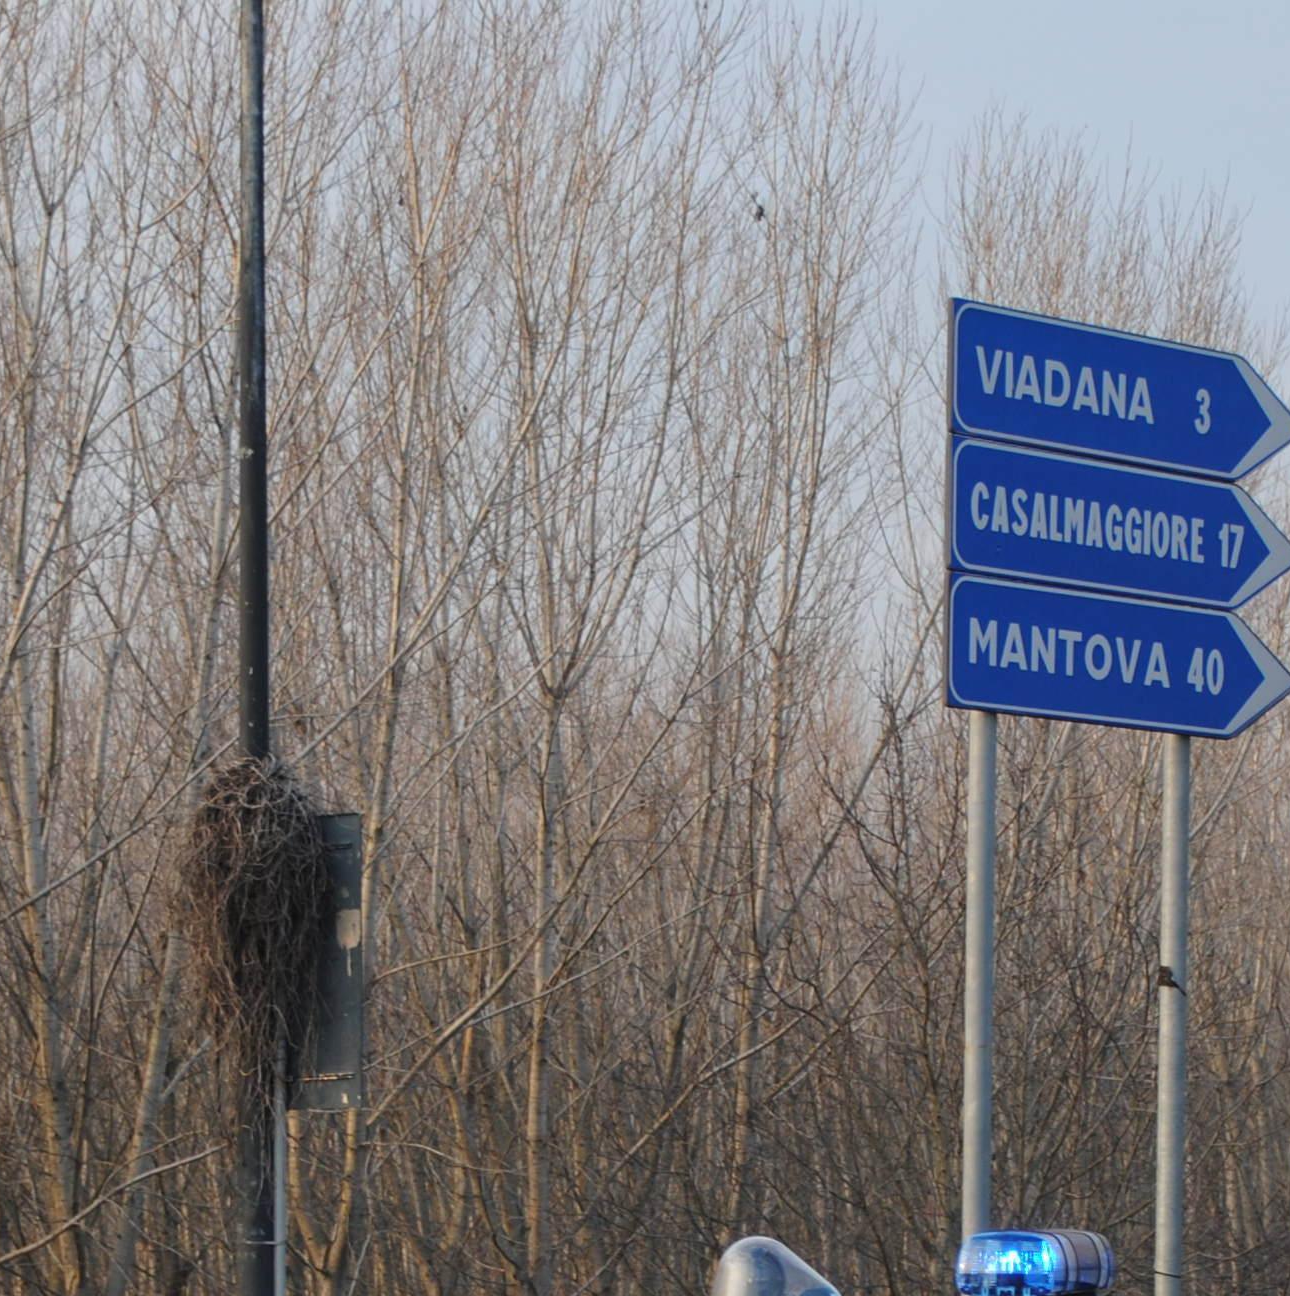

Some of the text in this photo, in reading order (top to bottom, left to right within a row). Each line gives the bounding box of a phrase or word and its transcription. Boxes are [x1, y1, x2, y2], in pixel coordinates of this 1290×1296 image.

[975, 345, 1211, 435] VIADANA 3
[970, 482, 1245, 569] CASALMAGGIORE 17
[968, 617, 1225, 695] MANTOVA 40
